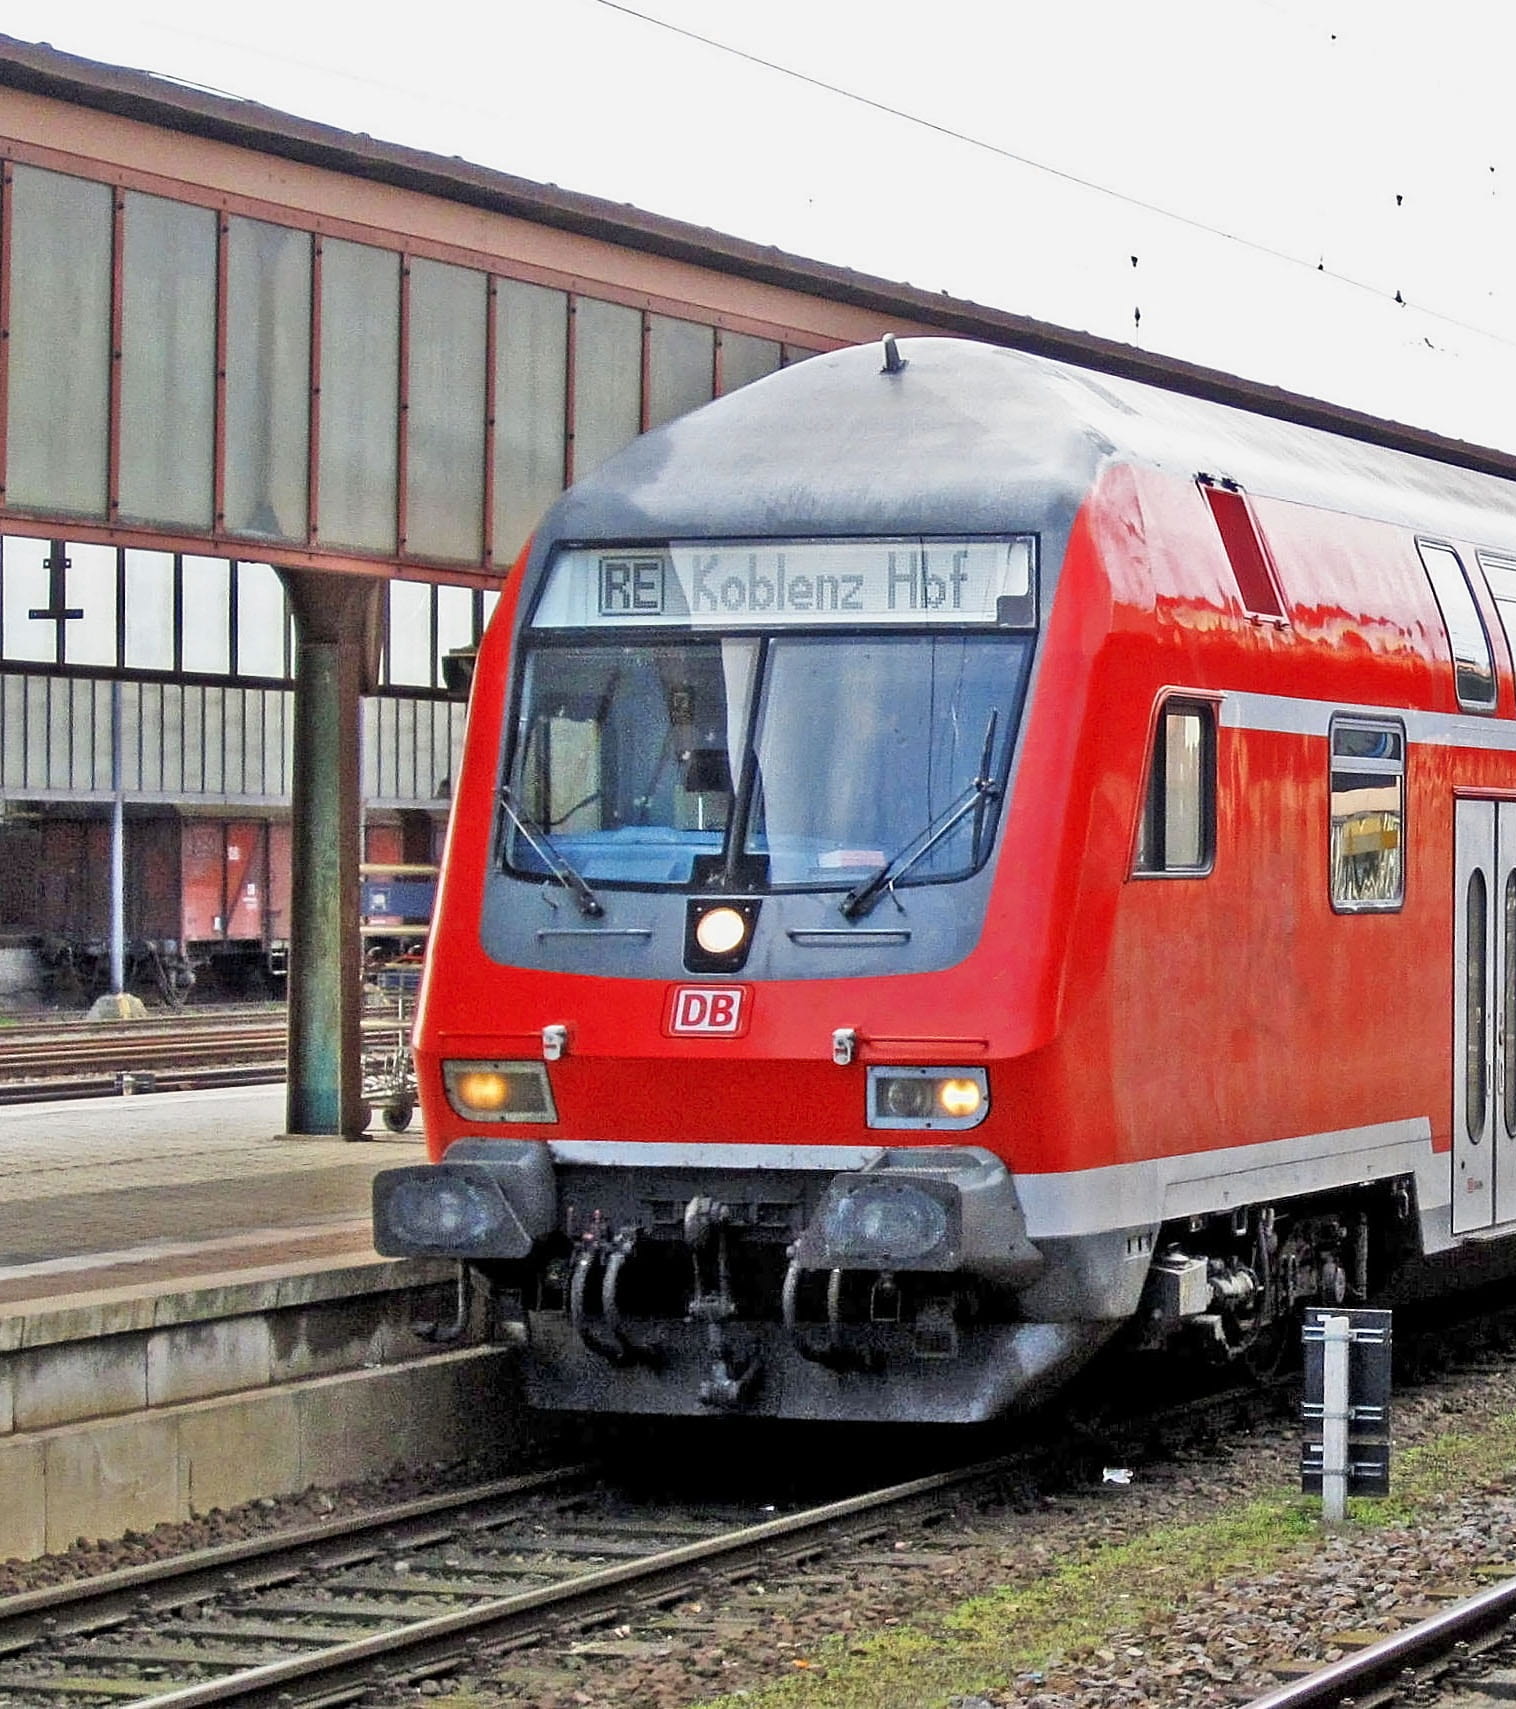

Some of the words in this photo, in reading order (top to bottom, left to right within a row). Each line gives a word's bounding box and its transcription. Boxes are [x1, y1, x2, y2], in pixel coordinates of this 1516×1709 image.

[604, 562, 660, 609] RE
[692, 553, 864, 611] Koblenz
[886, 549, 969, 610] Hbf
[680, 994, 735, 1027] DB
